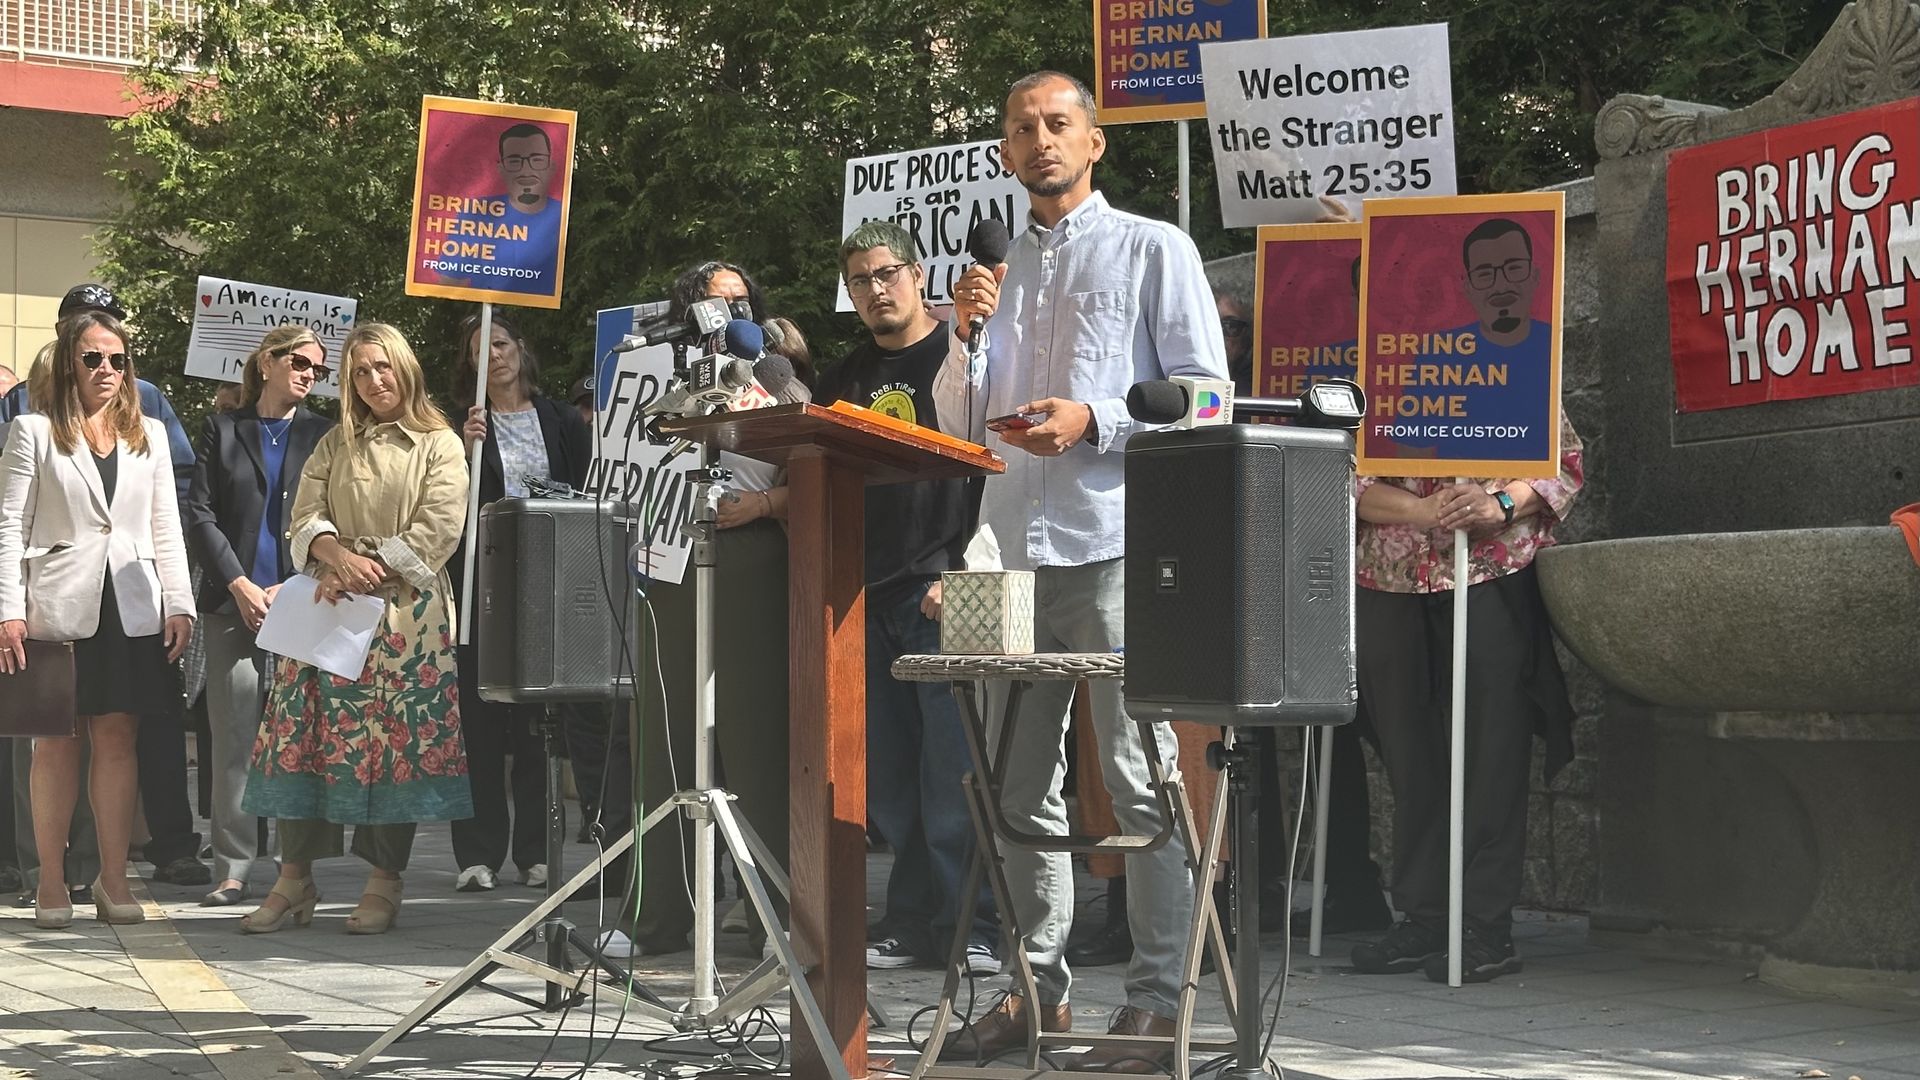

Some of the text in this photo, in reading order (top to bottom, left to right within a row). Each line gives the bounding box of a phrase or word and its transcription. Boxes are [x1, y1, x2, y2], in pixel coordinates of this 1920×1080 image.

[1109, 0, 1195, 21] BRING
[1110, 20, 1223, 47] HERNAN
[1110, 49, 1189, 73] HOME
[1111, 77, 1149, 90] FROM
[1152, 76, 1175, 87] ICE
[1238, 63, 1410, 101] Welcome
[1217, 112, 1443, 152] the Stranger
[853, 144, 1016, 196] DUE PROCES
[1235, 158, 1432, 200] Matt 25:35
[1716, 134, 1895, 237] BRING
[428, 194, 506, 217] BRING
[896, 188, 961, 213] is an
[426, 216, 528, 242] HERNAN
[424, 238, 496, 261] HOME
[1695, 200, 1920, 315] HERNAN
[422, 259, 542, 280] FROM ICE CUSTODY
[232, 310, 244, 326] A
[1376, 332, 1476, 355] BRING
[1723, 286, 1911, 385] HOME
[1375, 364, 1507, 386] HERNAN
[1223, 384, 1232, 428] NOTICIAS
[1374, 395, 1468, 417] HOME
[1374, 425, 1529, 438] FROM ICE CUSTODY
[1309, 546, 1333, 601] JBL
[576, 579, 597, 618] JBL
